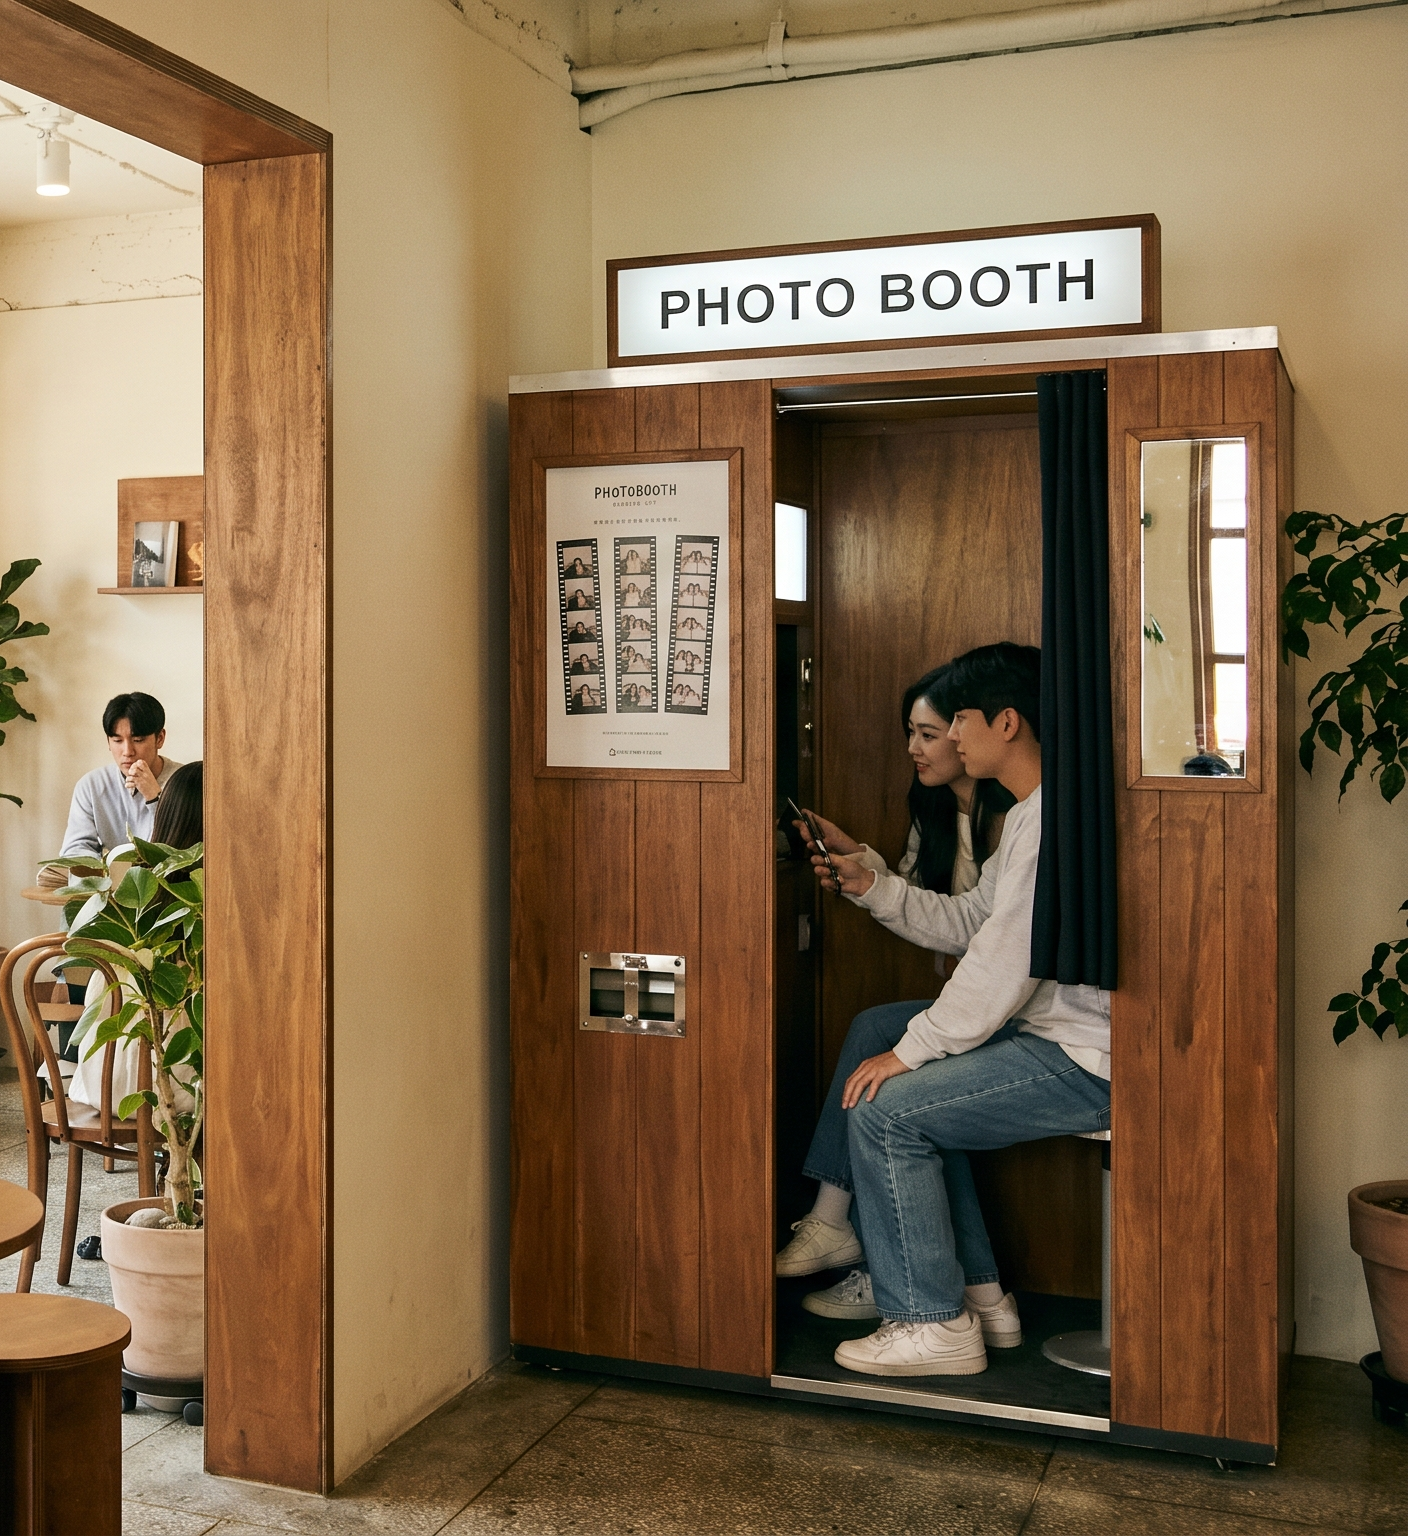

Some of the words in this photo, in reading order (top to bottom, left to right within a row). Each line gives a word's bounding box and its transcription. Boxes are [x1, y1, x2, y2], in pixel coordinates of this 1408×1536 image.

[661, 277, 854, 329] PHOTO
[880, 259, 1094, 314] BOOTH
[594, 483, 677, 499] PHOTOBOOTH
